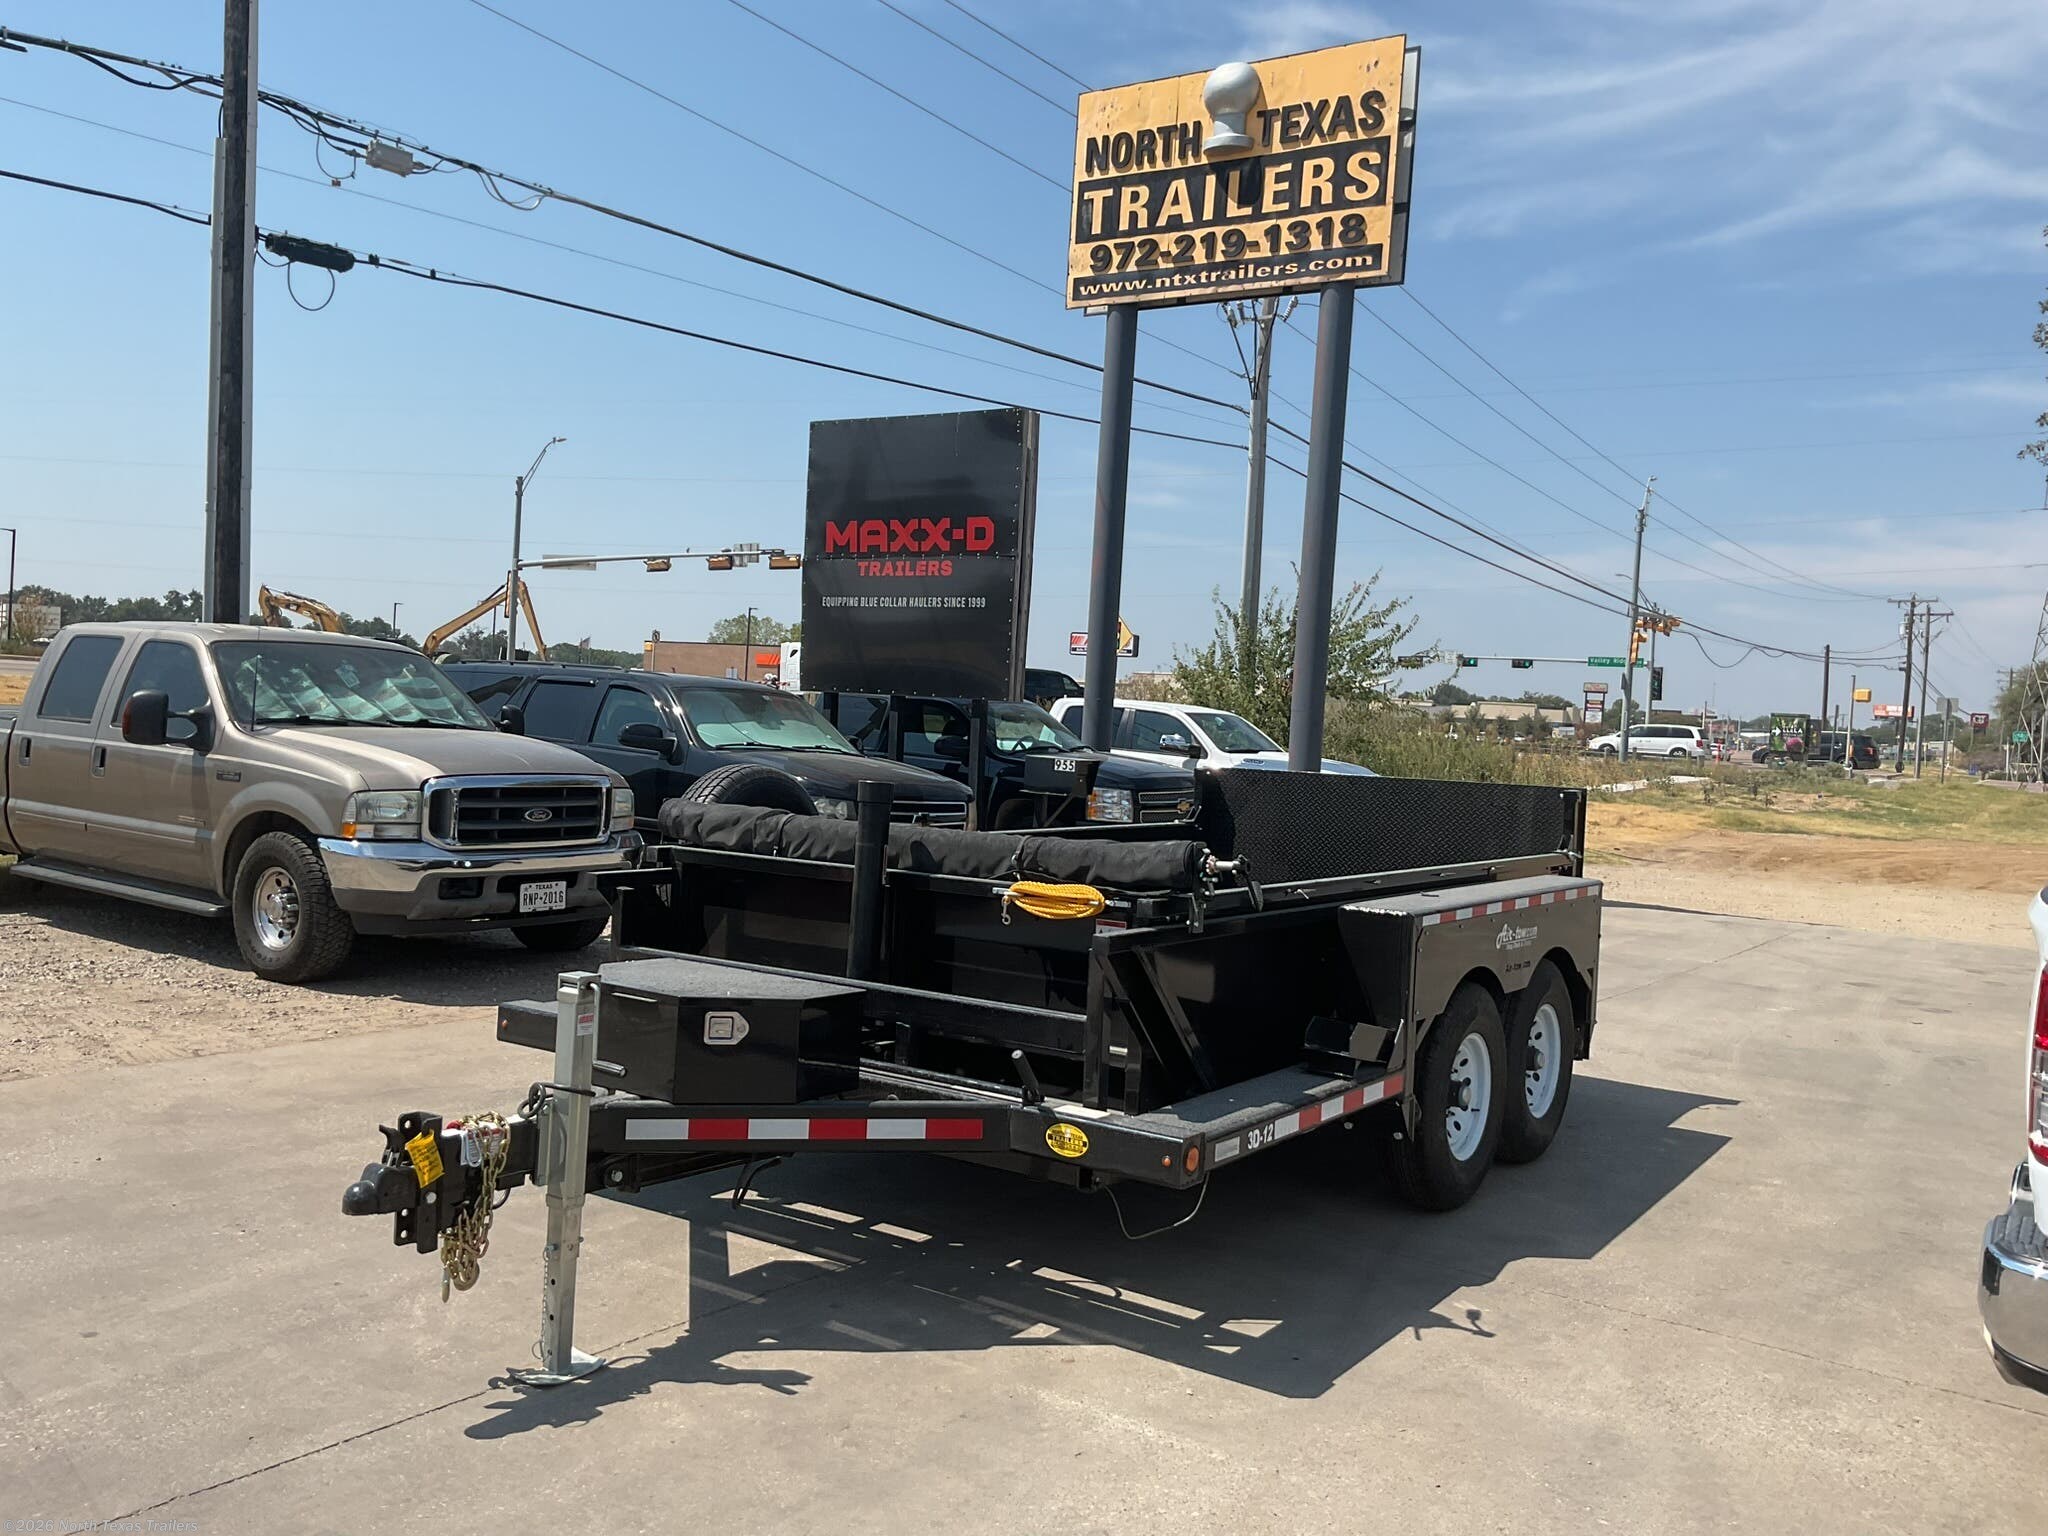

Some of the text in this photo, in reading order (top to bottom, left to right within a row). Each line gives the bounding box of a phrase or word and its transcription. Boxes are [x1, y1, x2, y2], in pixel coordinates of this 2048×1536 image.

[1085, 90, 1386, 174] NORTH TEXAS
[1083, 151, 1382, 236] TRAILERS
[1089, 213, 1367, 273] 972-219-1318
[1078, 253, 1373, 296] www.ntxtrailers.com
[825, 516, 995, 553] MAXX-D
[857, 560, 953, 577] TRAILERS
[822, 596, 986, 608] EQUIPPING BLUE COLLAR HAULERS SINCE 1999
[1055, 760, 1075, 771] 955
[1247, 1123, 1275, 1150] 3D-12
